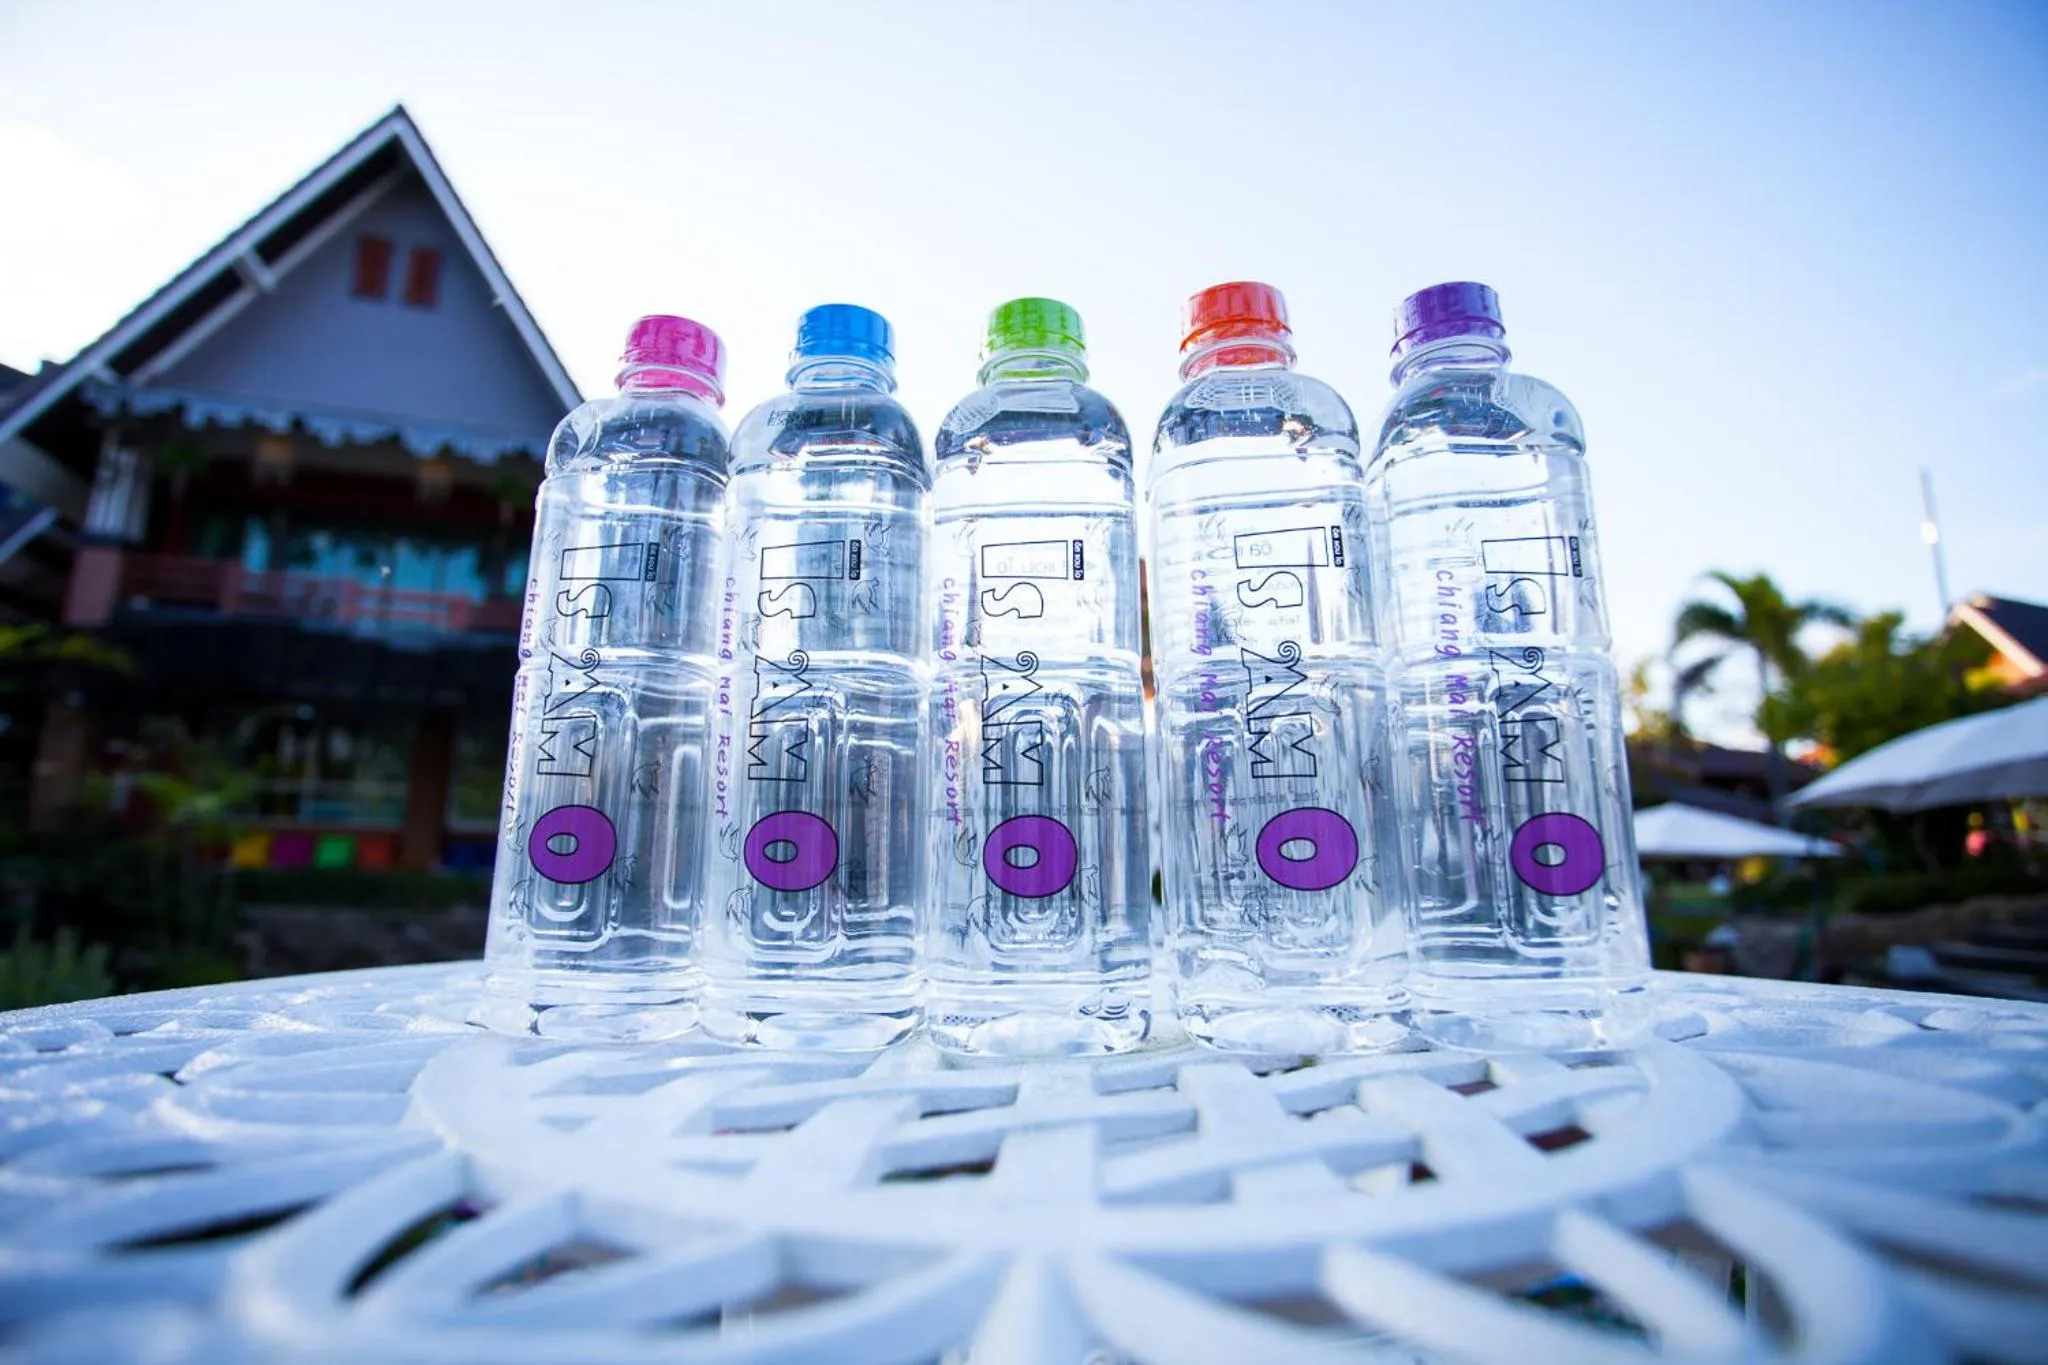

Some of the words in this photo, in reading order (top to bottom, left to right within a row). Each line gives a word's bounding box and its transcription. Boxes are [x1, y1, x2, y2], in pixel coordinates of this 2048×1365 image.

[719, 577, 740, 660] chiang
[939, 577, 961, 661] chiang
[1190, 568, 1214, 656] chiang
[1434, 570, 1463, 659] chiang
[537, 648, 600, 778] AM
[717, 676, 733, 716] Mai
[748, 650, 813, 783] AM
[981, 650, 1044, 786] AM
[1198, 673, 1222, 716] Mai
[1239, 640, 1318, 779] AM
[1443, 674, 1469, 717] Mai
[1490, 647, 1564, 783] AM
[715, 734, 731, 820] Resort
[943, 738, 963, 826] Resort
[1204, 730, 1231, 821] Resort
[1451, 735, 1484, 825] Resort
[528, 803, 618, 885] O
[743, 810, 840, 893] O
[982, 814, 1079, 899] O
[1255, 806, 1360, 892] O
[1510, 812, 1606, 897] O
